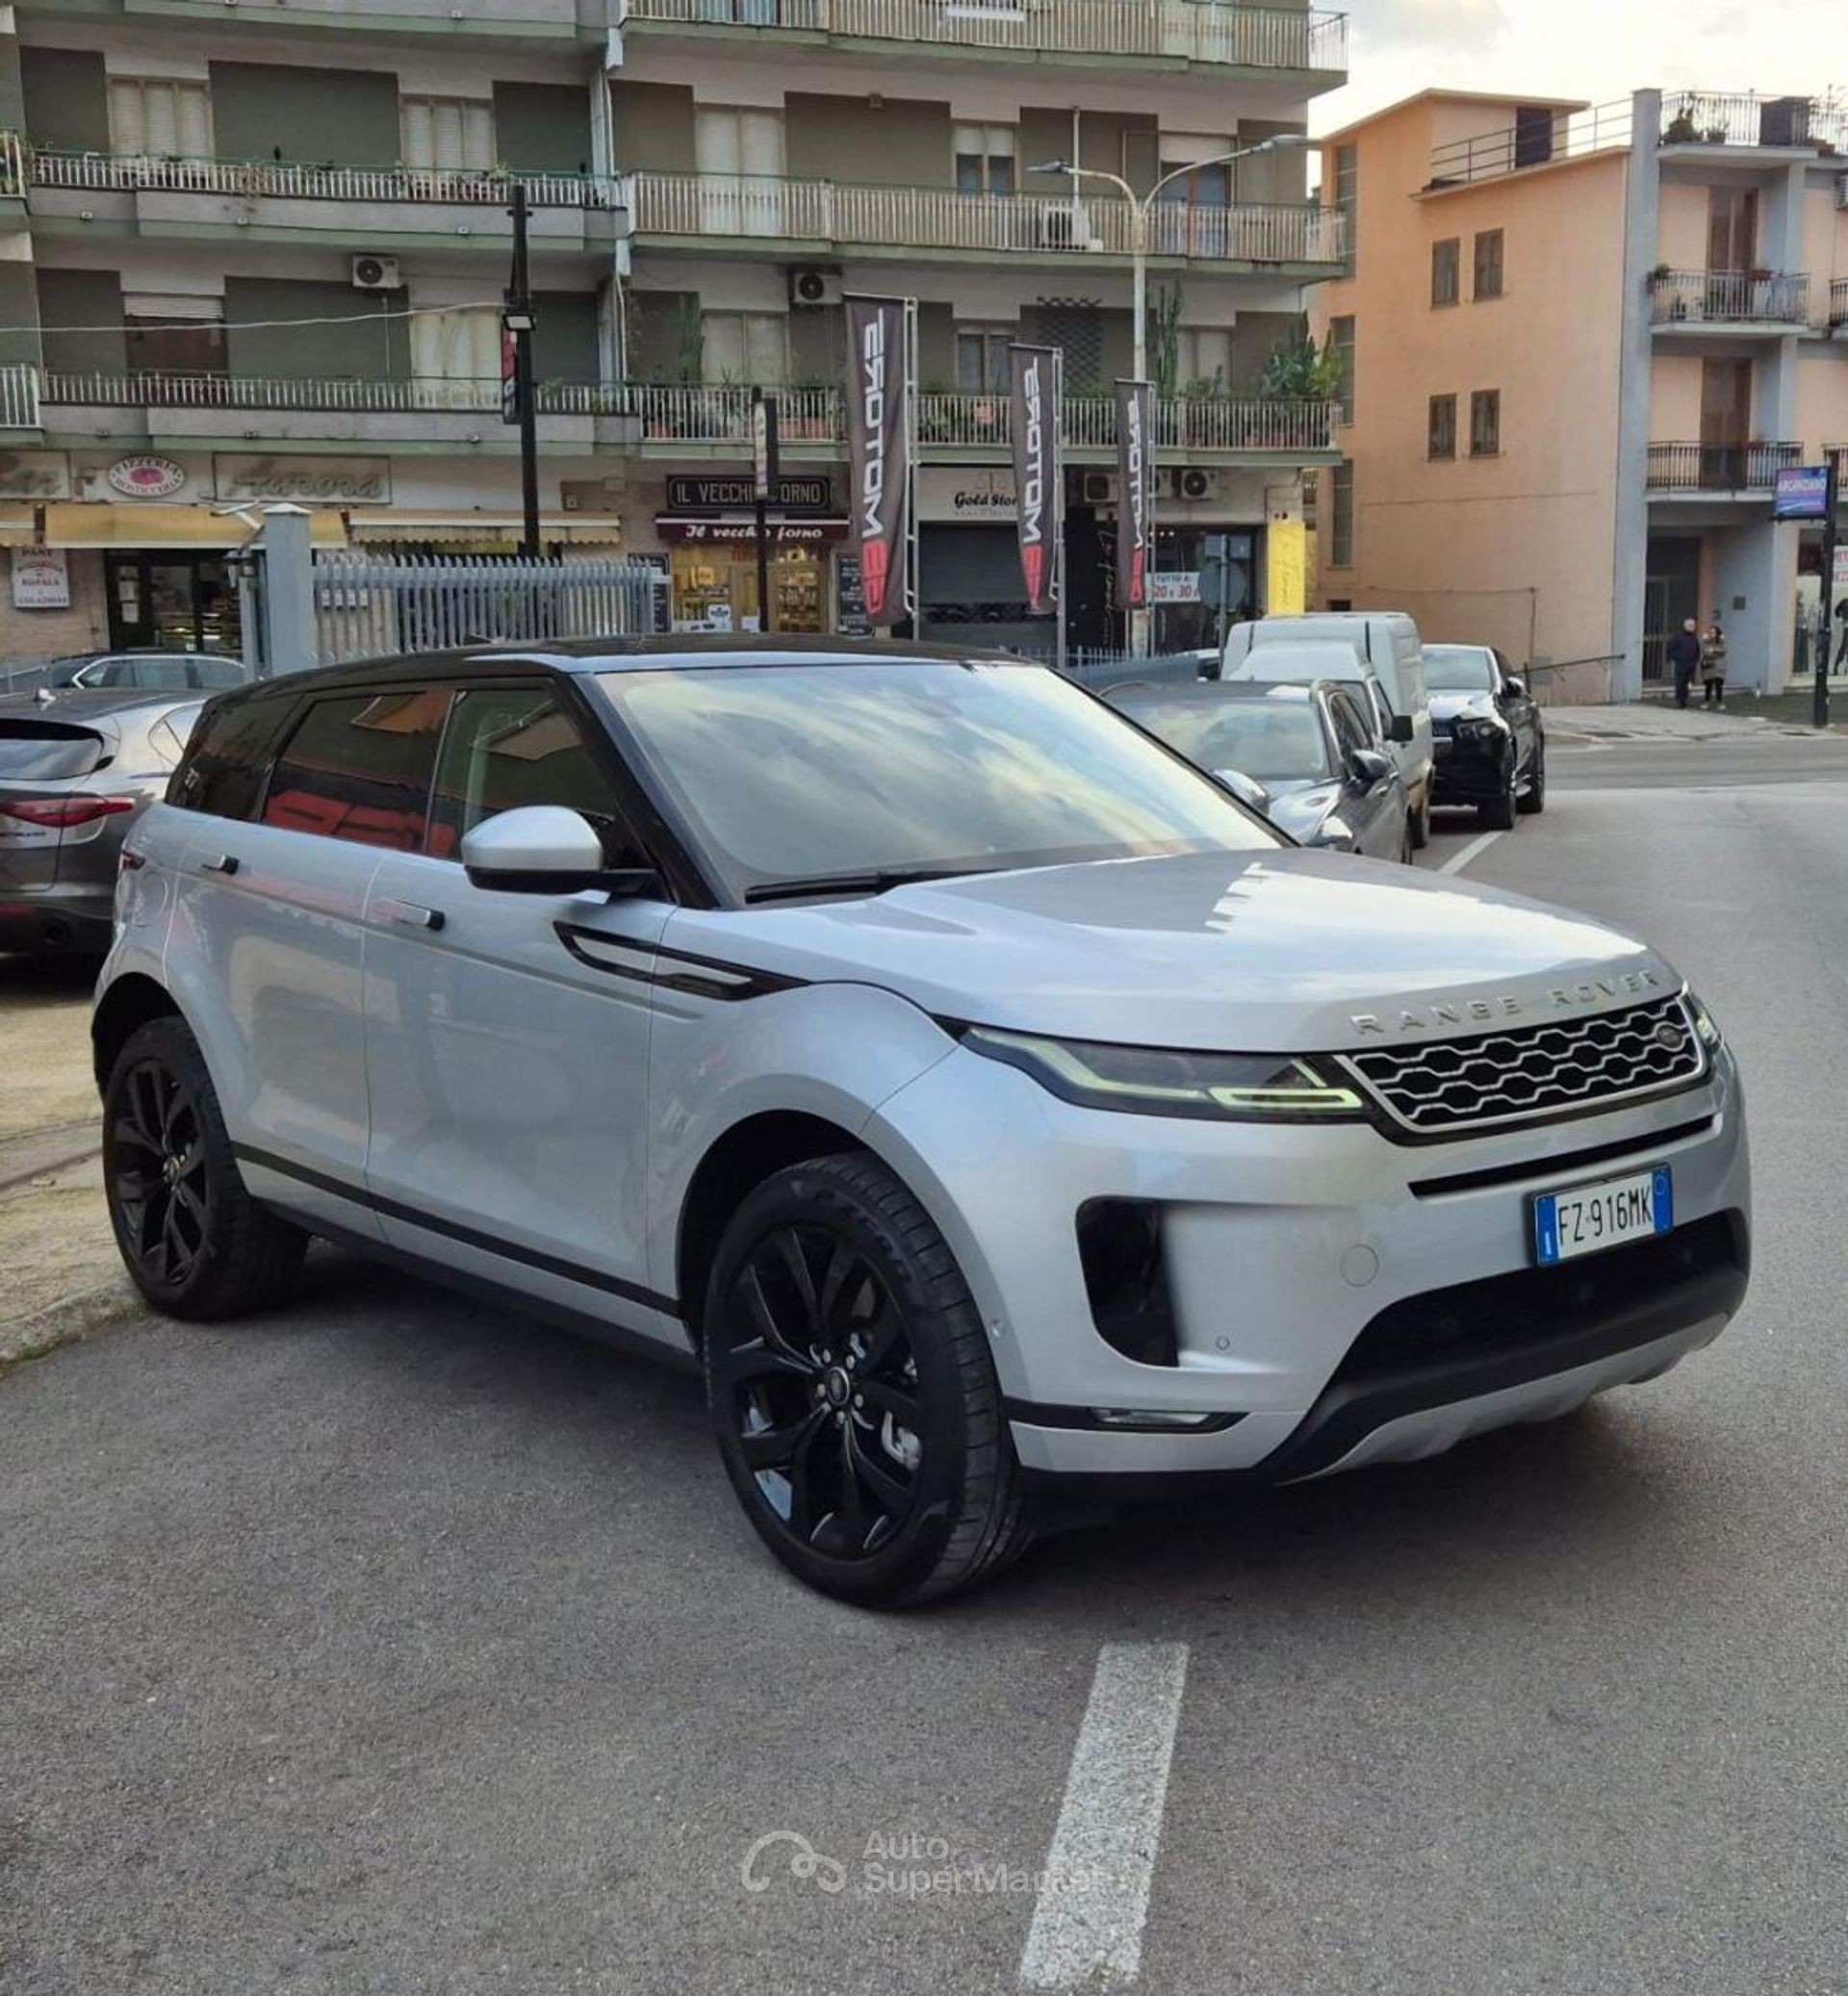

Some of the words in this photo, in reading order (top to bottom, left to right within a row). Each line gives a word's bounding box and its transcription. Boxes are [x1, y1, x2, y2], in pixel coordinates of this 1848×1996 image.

[677, 483, 691, 503] IL
[699, 483, 757, 503] VECCHI
[774, 483, 822, 503] ORNO
[991, 493, 1017, 507] Stor
[778, 525, 824, 541] forno
[1350, 995, 1522, 1036] RANGE
[1547, 968, 1660, 1009] ROVER
